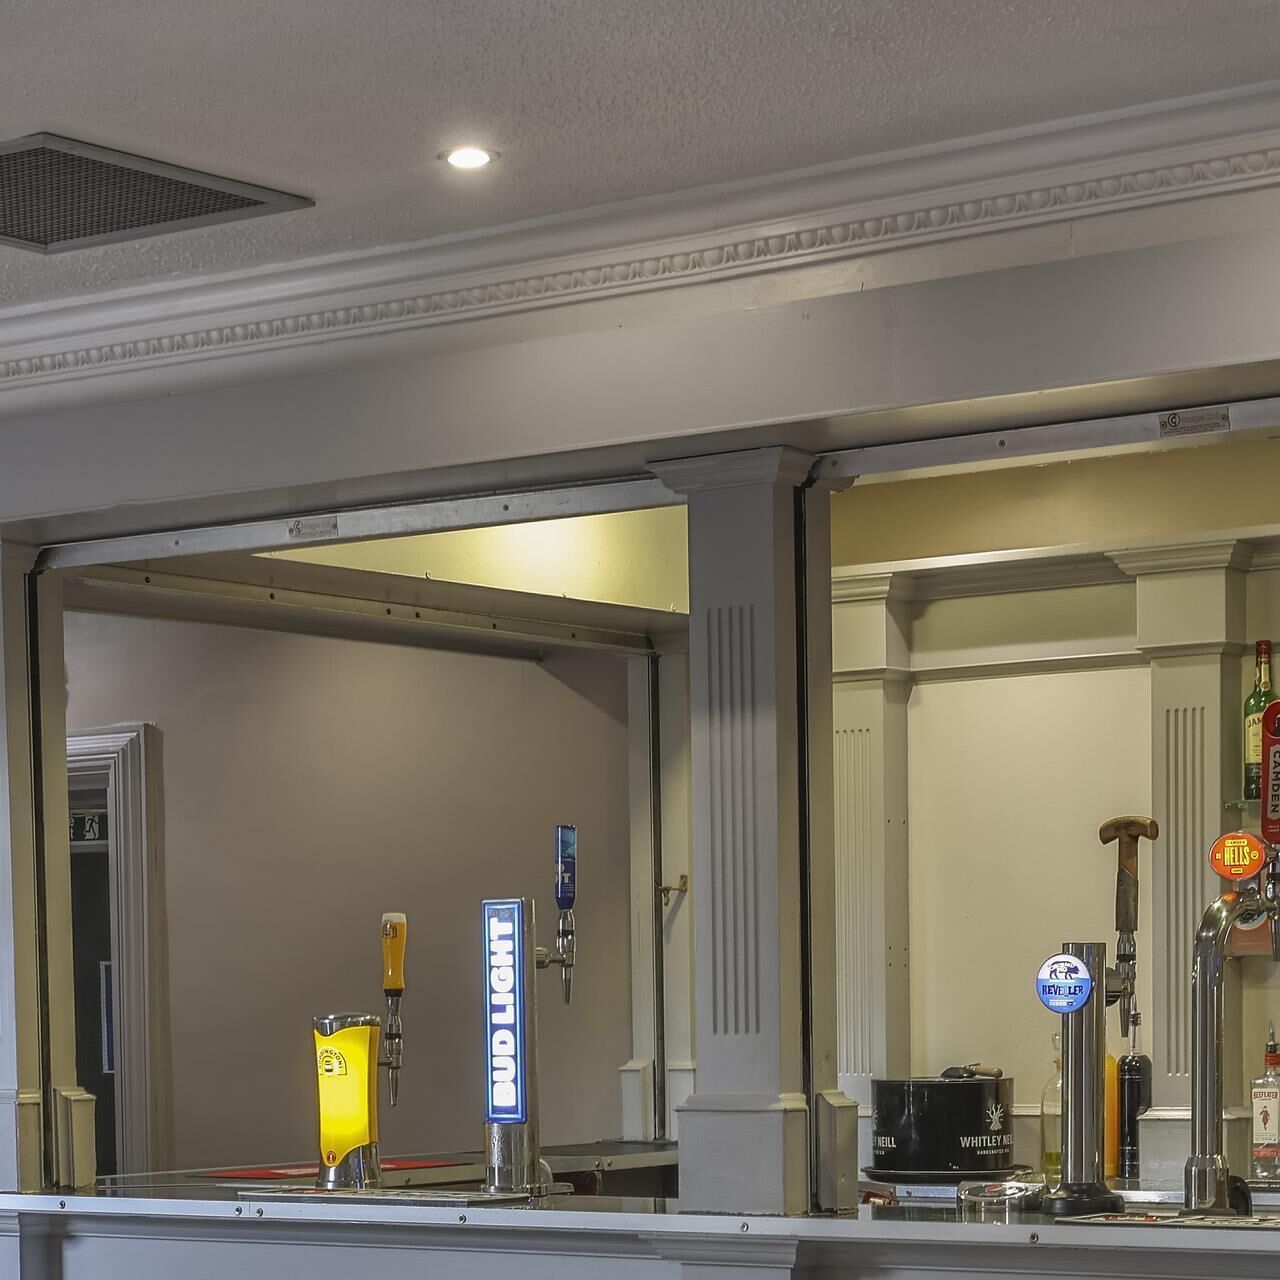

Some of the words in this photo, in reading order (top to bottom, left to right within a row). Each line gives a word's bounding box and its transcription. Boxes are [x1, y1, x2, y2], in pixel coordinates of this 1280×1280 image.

[1224, 846, 1250, 866] HELLS
[490, 917, 515, 1024] LIGHT
[1042, 984, 1084, 997] REVELLER
[492, 1029, 516, 1107] BUD
[1253, 1091, 1279, 1099] BEEFEATER
[877, 1136, 897, 1148] NEILL
[960, 1136, 1001, 1148] WHITLEY
